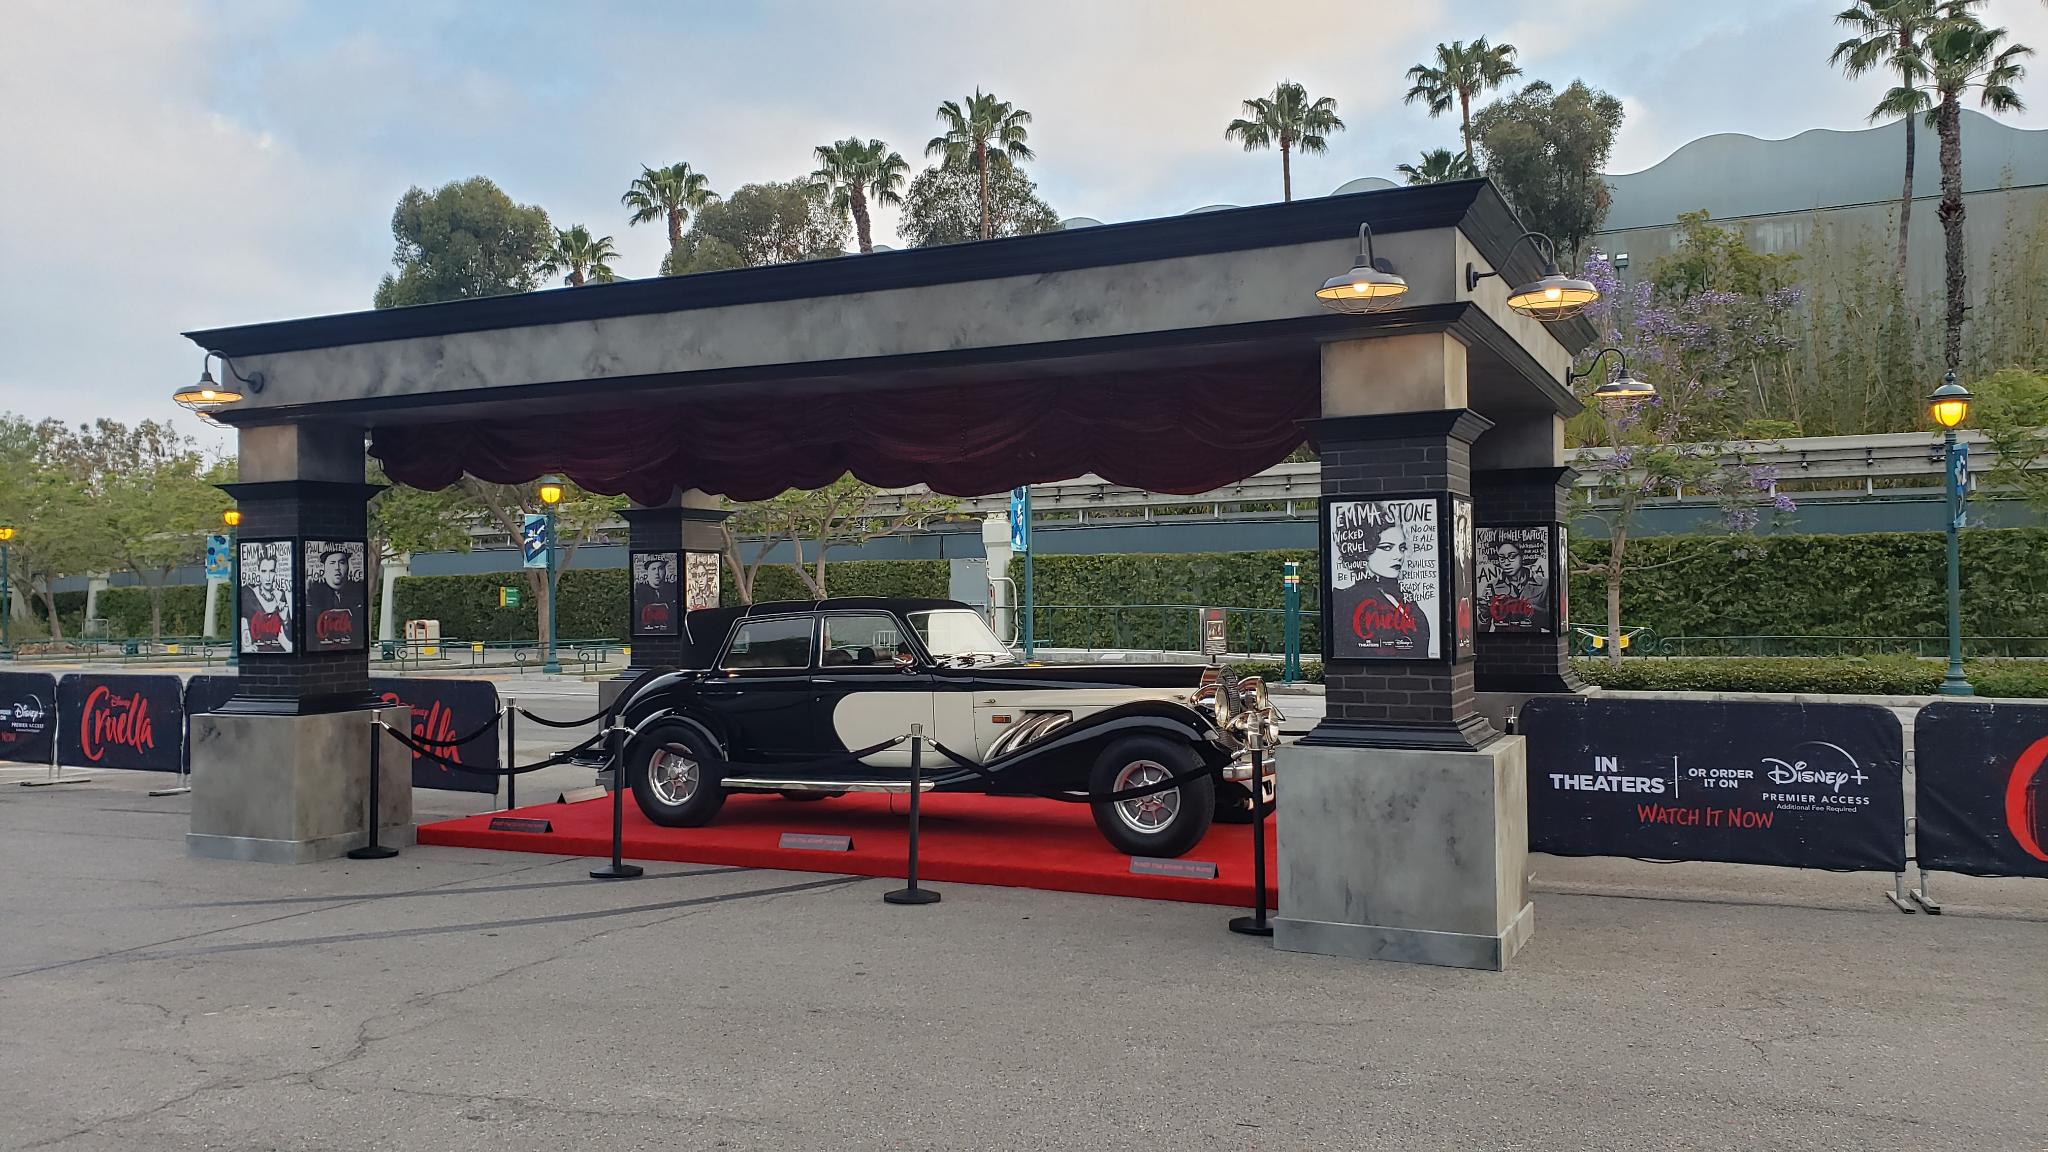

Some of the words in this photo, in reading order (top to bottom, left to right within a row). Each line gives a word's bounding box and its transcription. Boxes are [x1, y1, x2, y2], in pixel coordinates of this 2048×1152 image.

[1335, 502, 1382, 529] EMMA
[1385, 502, 1433, 523] STONE
[1410, 525, 1422, 533] NO
[1422, 524, 1436, 532] ONE
[1332, 529, 1364, 542] WICKED
[1420, 534, 1435, 542] ALL
[241, 544, 265, 560] EMMA
[306, 541, 322, 554] PAUL
[1341, 540, 1369, 554] CRUEL
[1413, 543, 1433, 552] BAD
[1337, 572, 1348, 581] BE
[1422, 582, 1435, 590] FOR
[1402, 591, 1436, 604] REVENGE
[81, 685, 155, 761] Cruella
[1595, 756, 1618, 773] IN
[1688, 767, 1707, 779] OR
[1710, 768, 1754, 780] ORDER
[1549, 774, 1665, 794] THEATERS
[1704, 778, 1716, 788] IT
[1718, 778, 1739, 789] ON
[1762, 792, 1816, 803] PREMIER
[1821, 795, 1870, 805] ACCESS
[1776, 803, 1811, 811] Additional
[1811, 804, 1825, 812] Fee
[1826, 805, 1857, 813] Required
[1637, 803, 1700, 826] WATCH
[1705, 806, 1724, 827] IT
[1728, 807, 1774, 829] NOW
